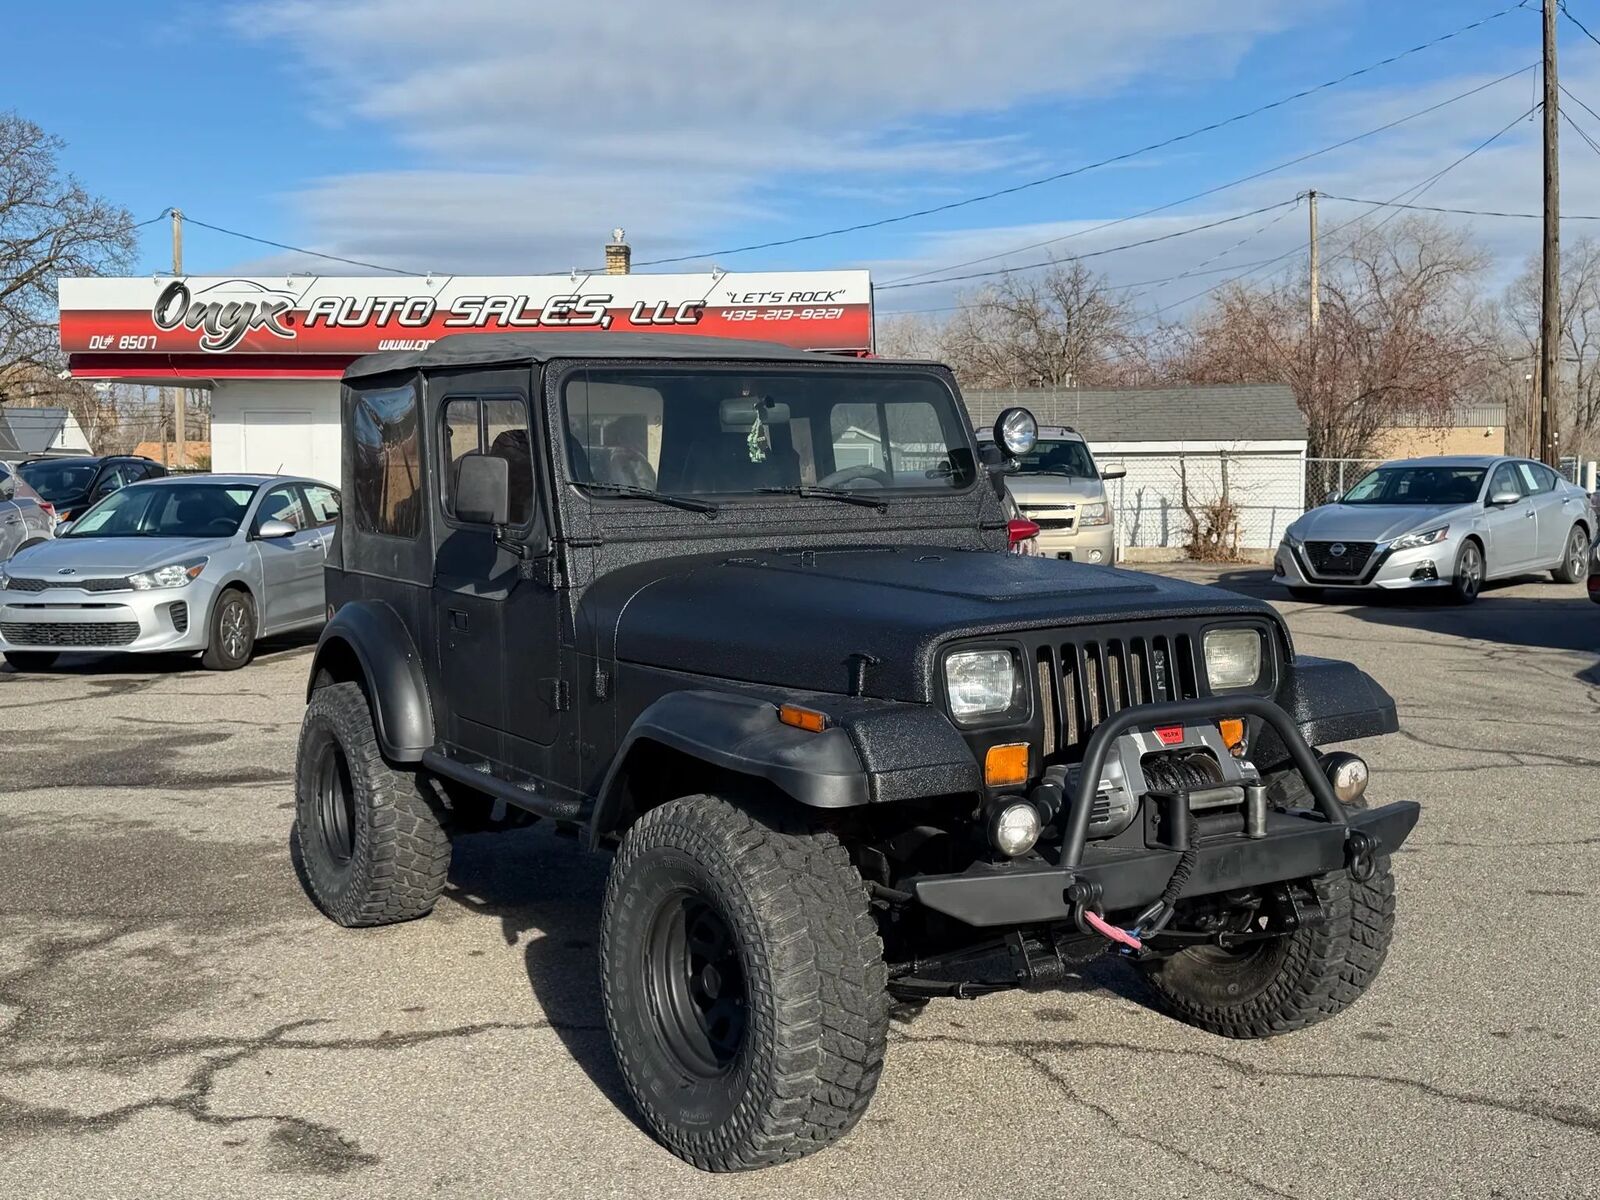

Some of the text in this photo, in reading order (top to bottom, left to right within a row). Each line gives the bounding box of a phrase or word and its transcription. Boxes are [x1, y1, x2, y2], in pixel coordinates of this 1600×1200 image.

[726, 289, 846, 304] "LET'S ROCK"
[153, 280, 707, 352] Onyx AUTO SALES, LLC
[721, 308, 844, 321] 435-213-9221
[89, 335, 157, 349] DL# 8507
